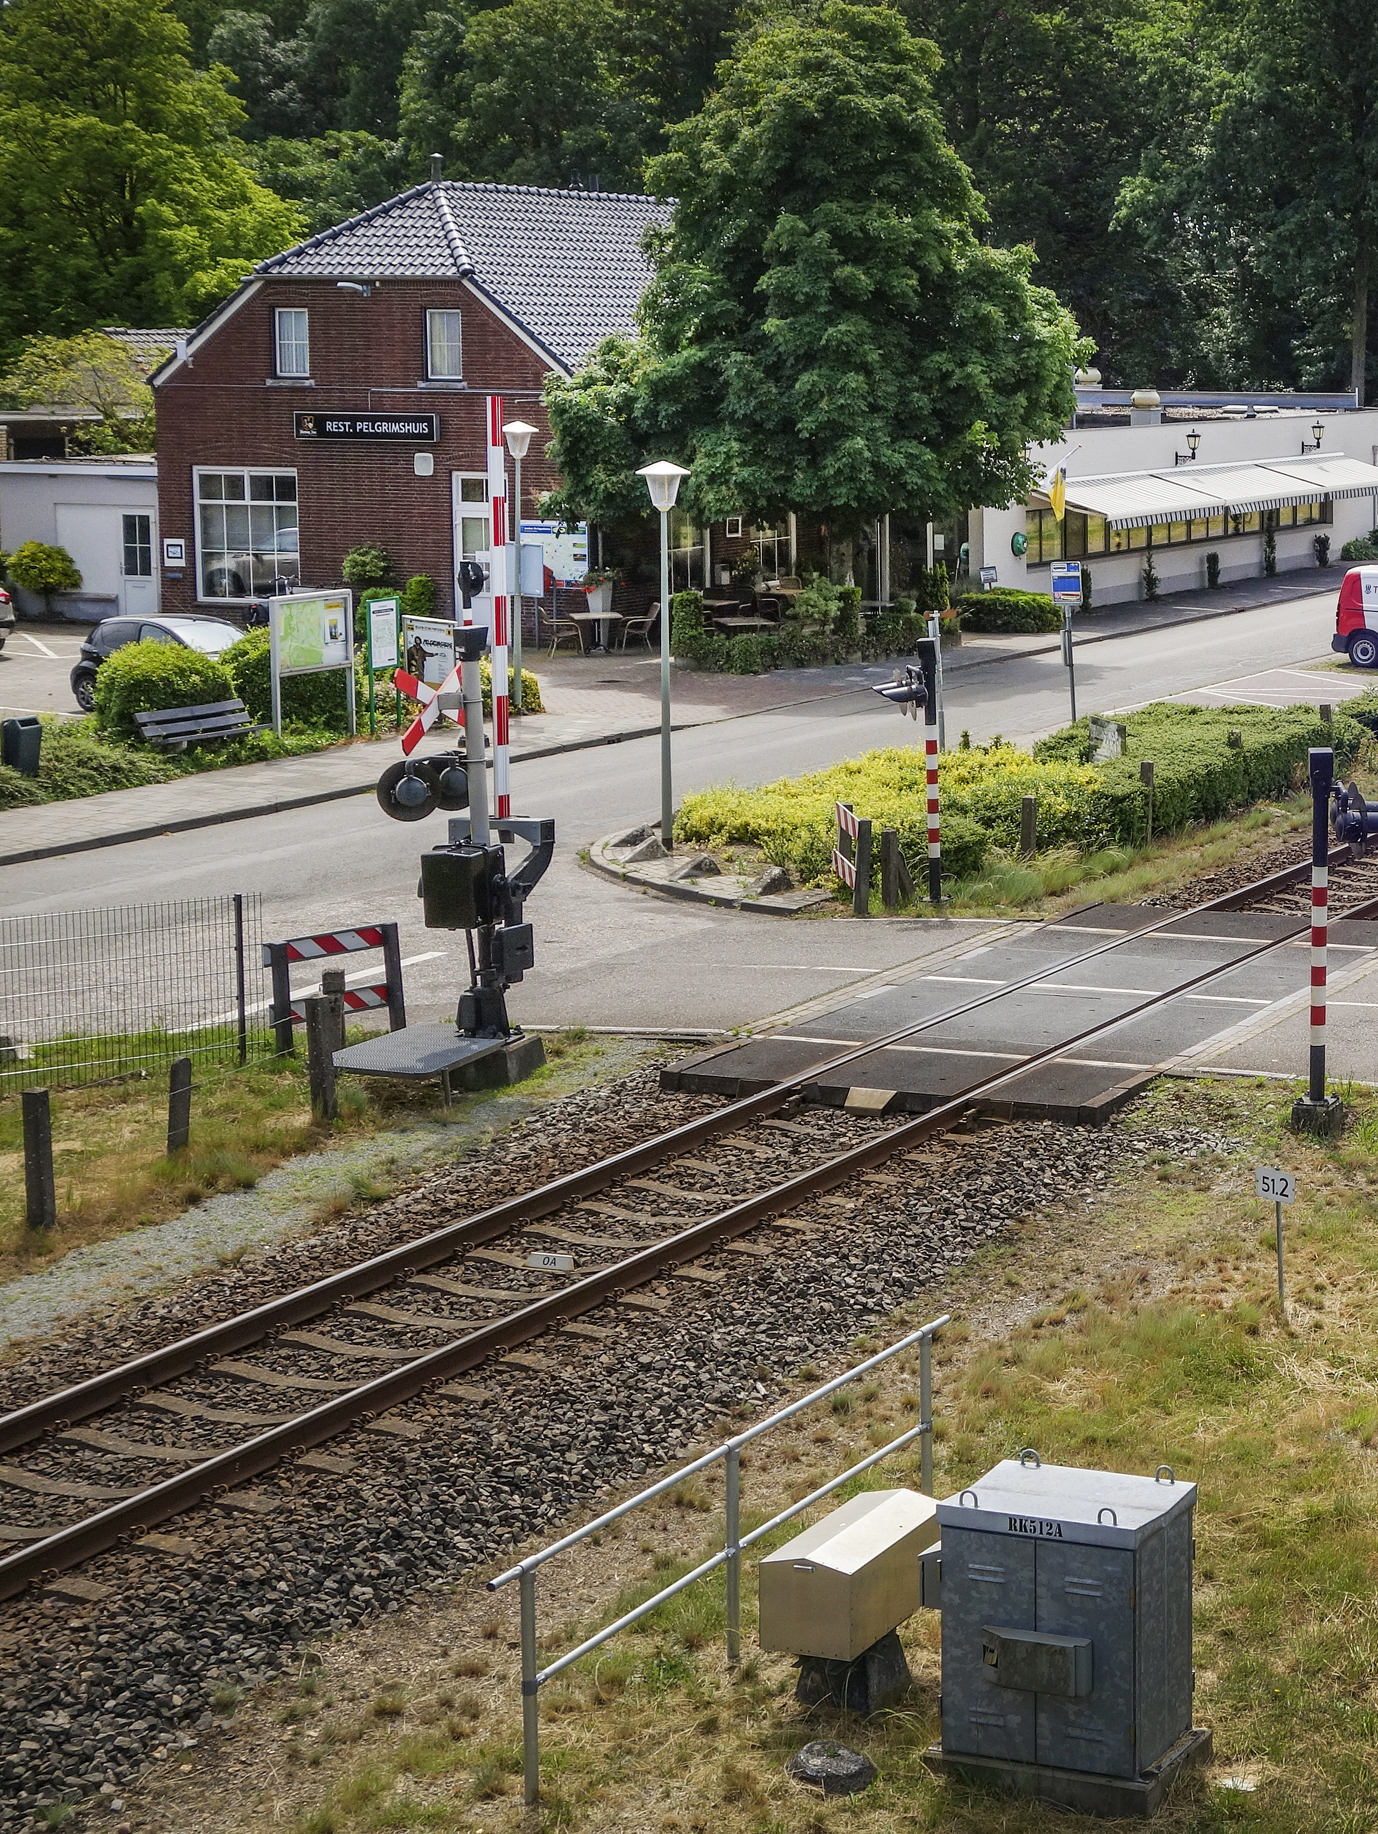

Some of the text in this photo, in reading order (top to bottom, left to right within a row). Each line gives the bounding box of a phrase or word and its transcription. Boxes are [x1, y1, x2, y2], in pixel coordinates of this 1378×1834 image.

[326, 421, 353, 432] REST.
[356, 421, 429, 434] PELGRIMSHUIS
[1261, 1175, 1289, 1198] 51.2
[1008, 1517, 1063, 1537] RK512A
